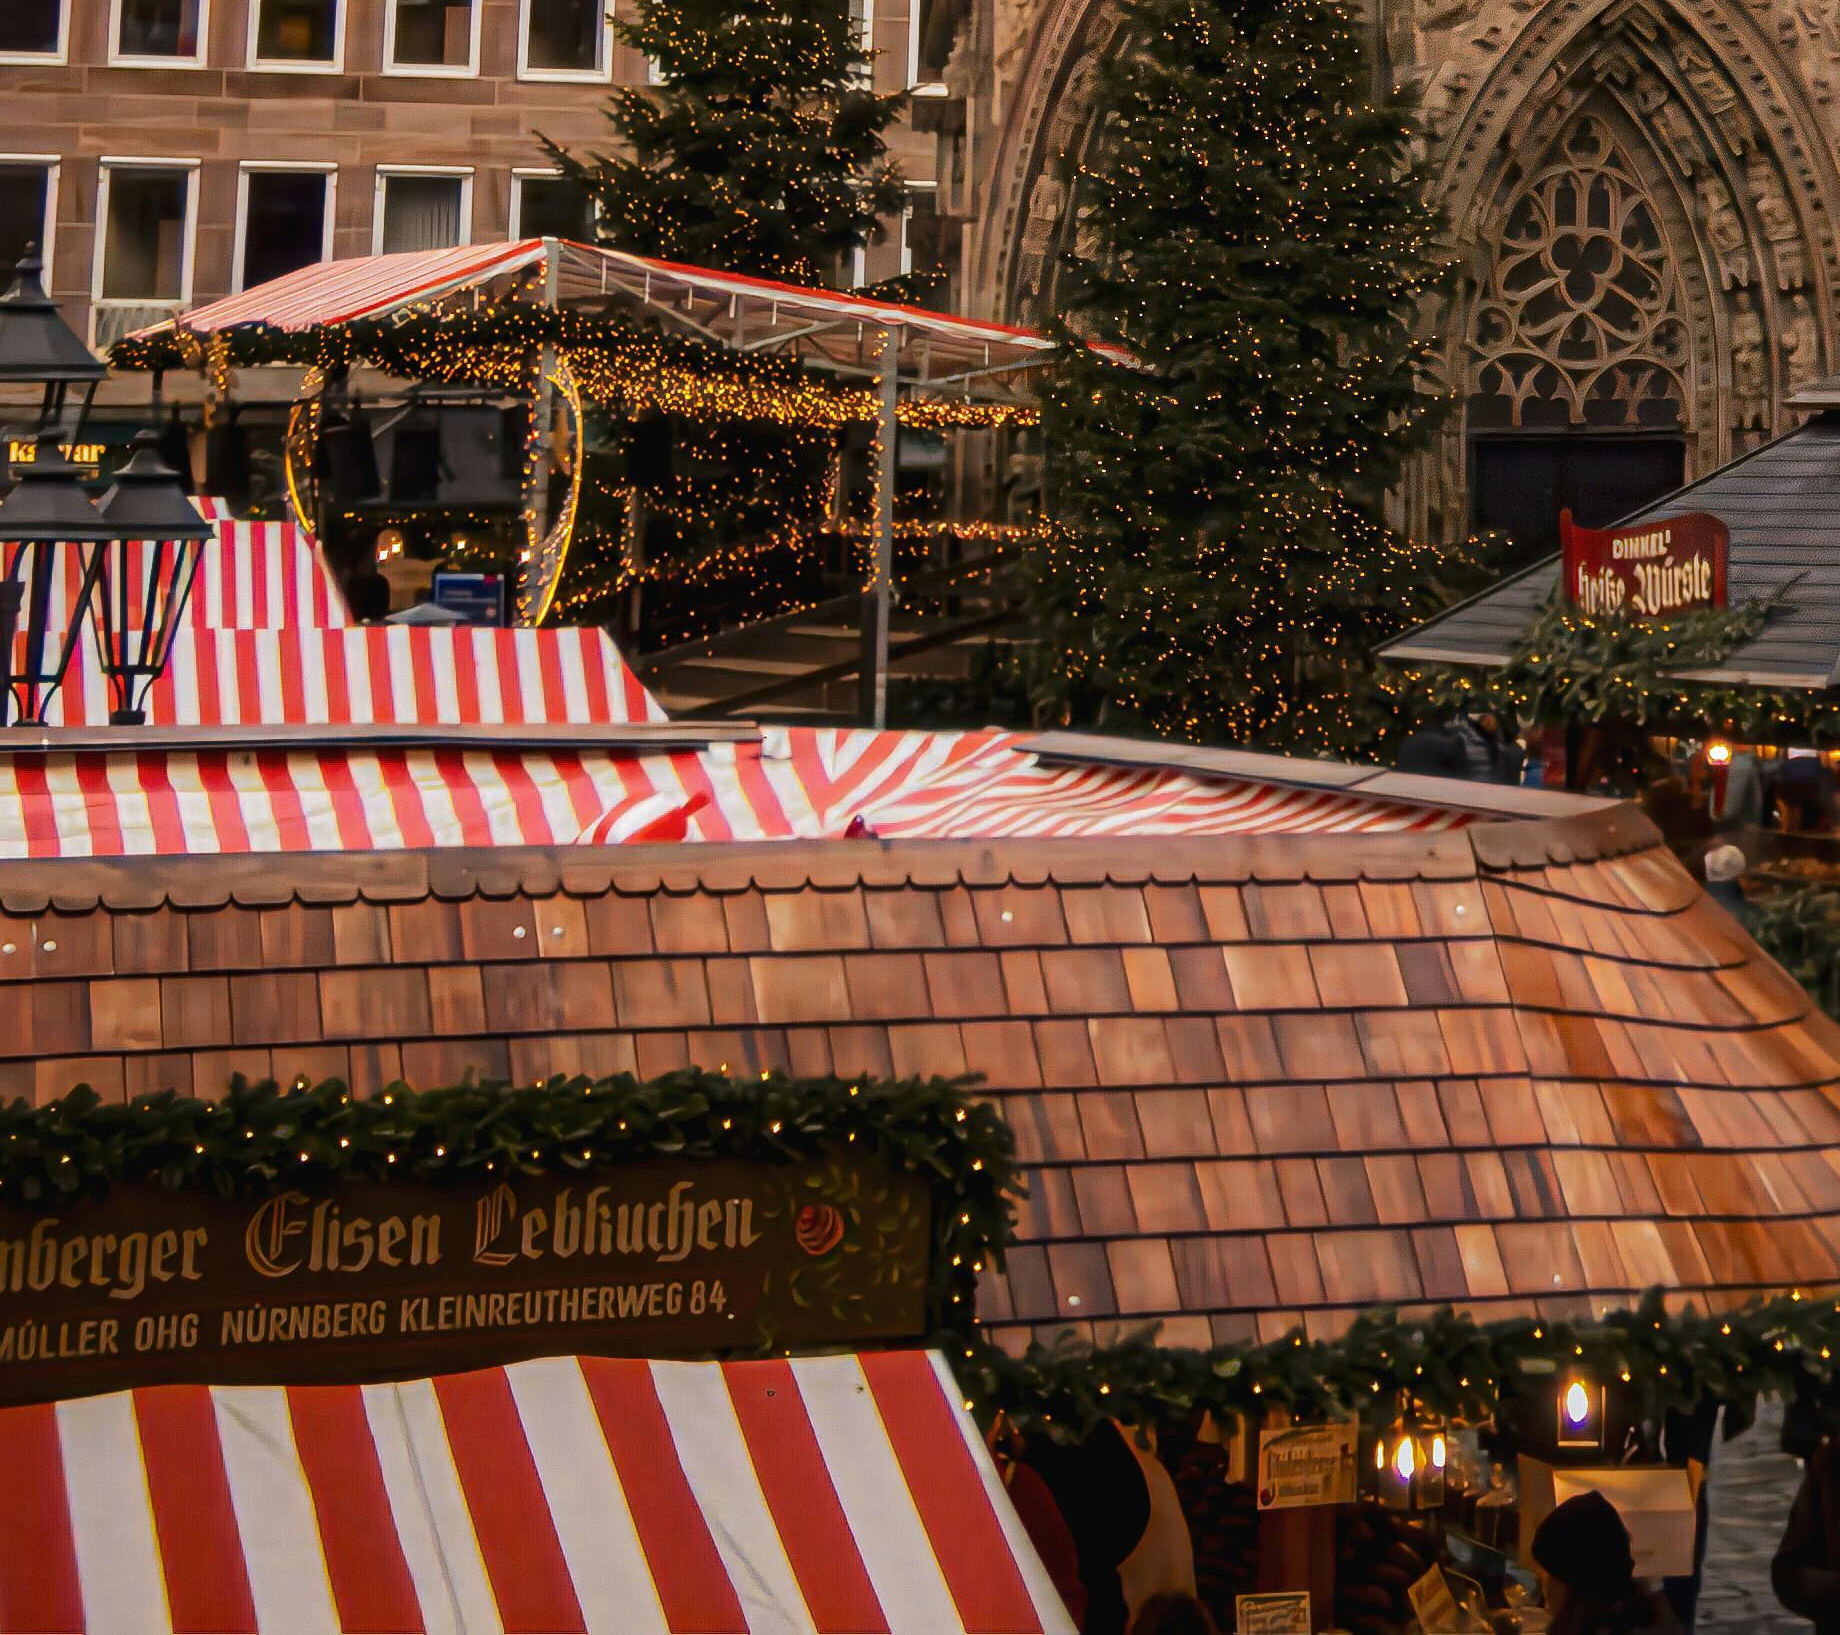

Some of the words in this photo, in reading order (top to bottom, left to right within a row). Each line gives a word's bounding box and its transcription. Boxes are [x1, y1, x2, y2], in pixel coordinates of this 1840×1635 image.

[1632, 551, 1712, 616] Würste
[245, 1190, 443, 1278] Elisen
[472, 1180, 763, 1267] Lebkuchen
[135, 1313, 199, 1352] OHG
[221, 1300, 386, 1346] NÜRNBERG
[400, 1283, 682, 1333] KLEINREUTHERWEG
[689, 1279, 727, 1315] 84
